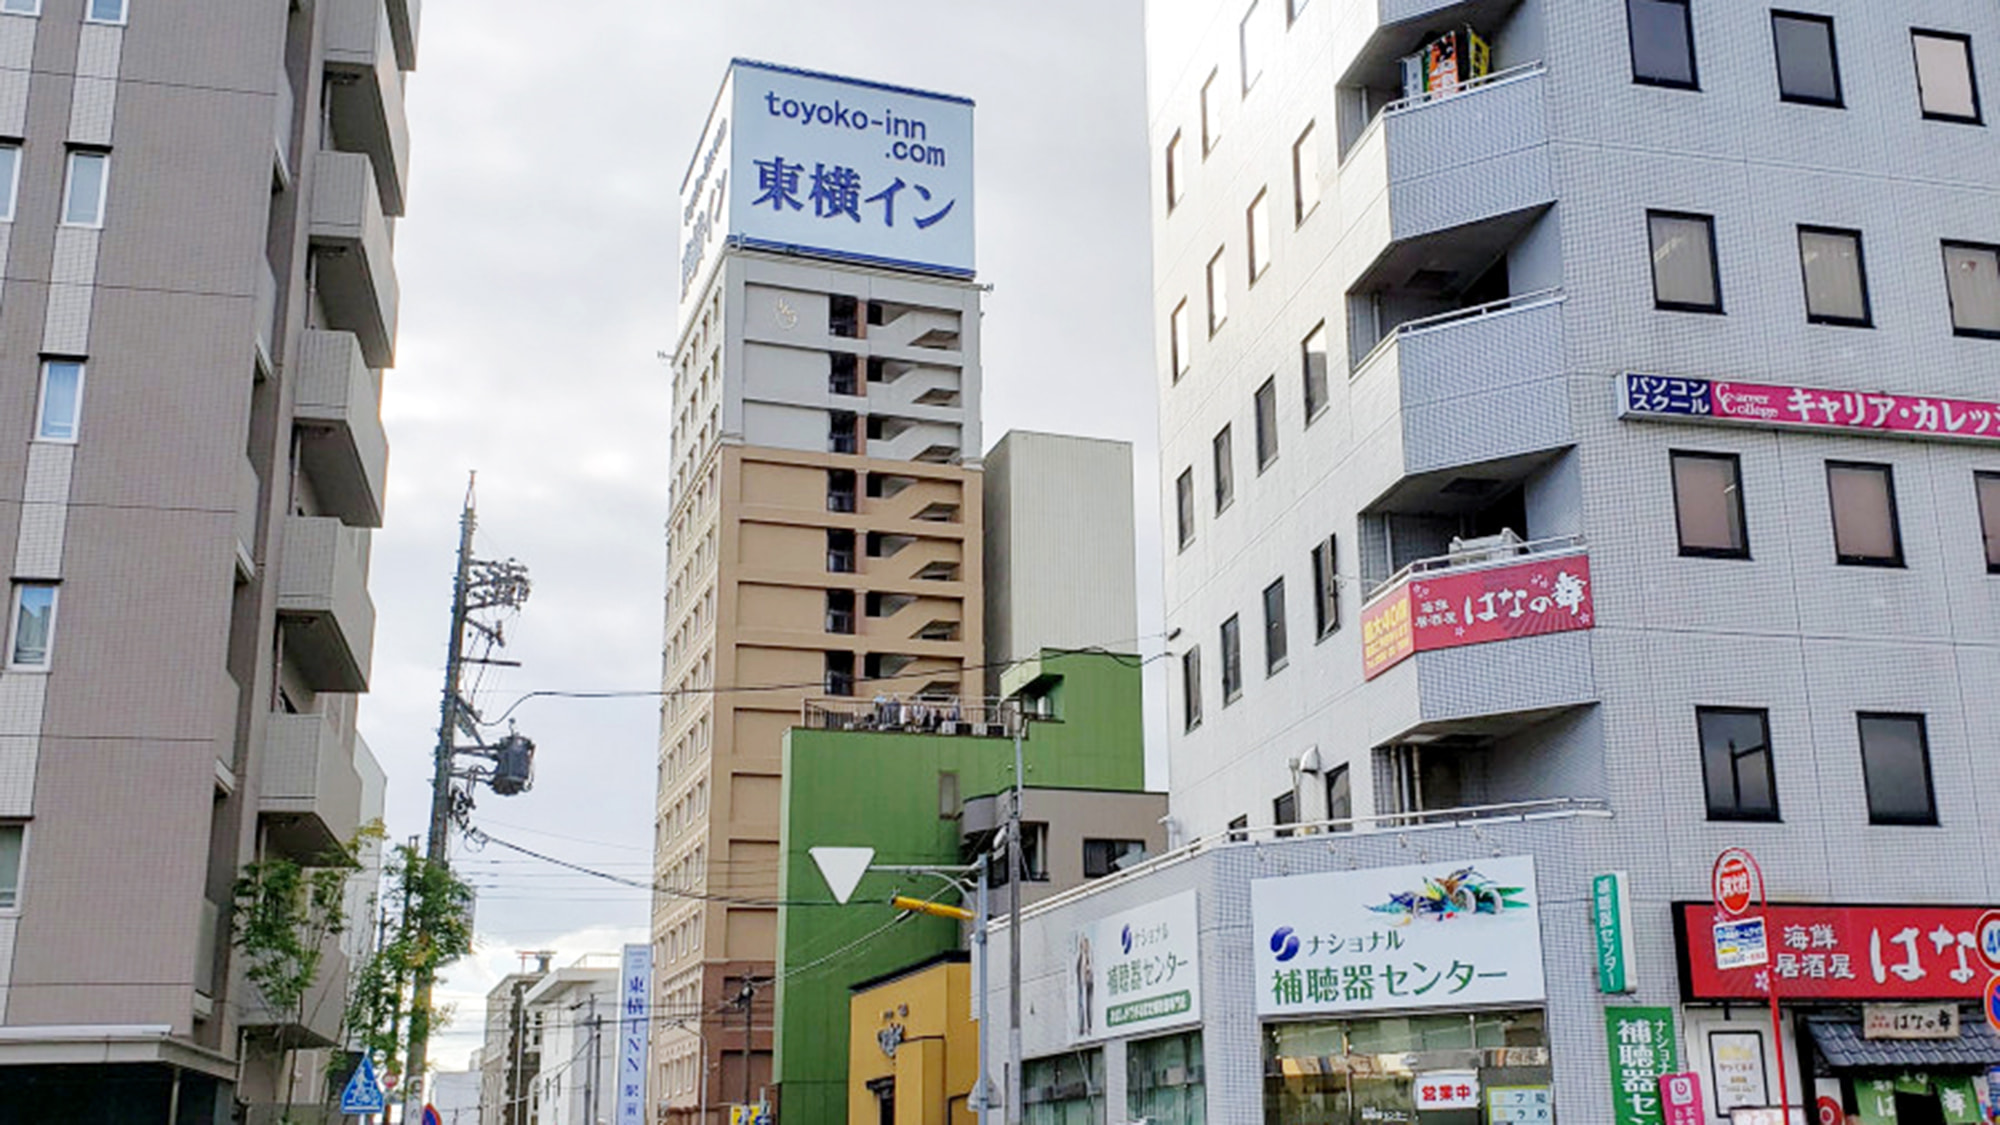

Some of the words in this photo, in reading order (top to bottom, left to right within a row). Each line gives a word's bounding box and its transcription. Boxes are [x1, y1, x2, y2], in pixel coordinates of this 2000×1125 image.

[764, 90, 926, 141] toyoko-inn
[885, 140, 946, 166] .com
[752, 156, 956, 229] 東横イン
[1631, 377, 1707, 396] パソコン
[1632, 395, 1710, 413] スクール
[1306, 930, 1405, 957] ナショナル
[1783, 923, 1838, 950] 海鮮
[1107, 951, 1188, 996] 補聴器センター
[1774, 953, 1856, 979] 居酒屋
[1270, 960, 1508, 1006] 補聴器センター
[1421, 1084, 1472, 1102] 営業中
